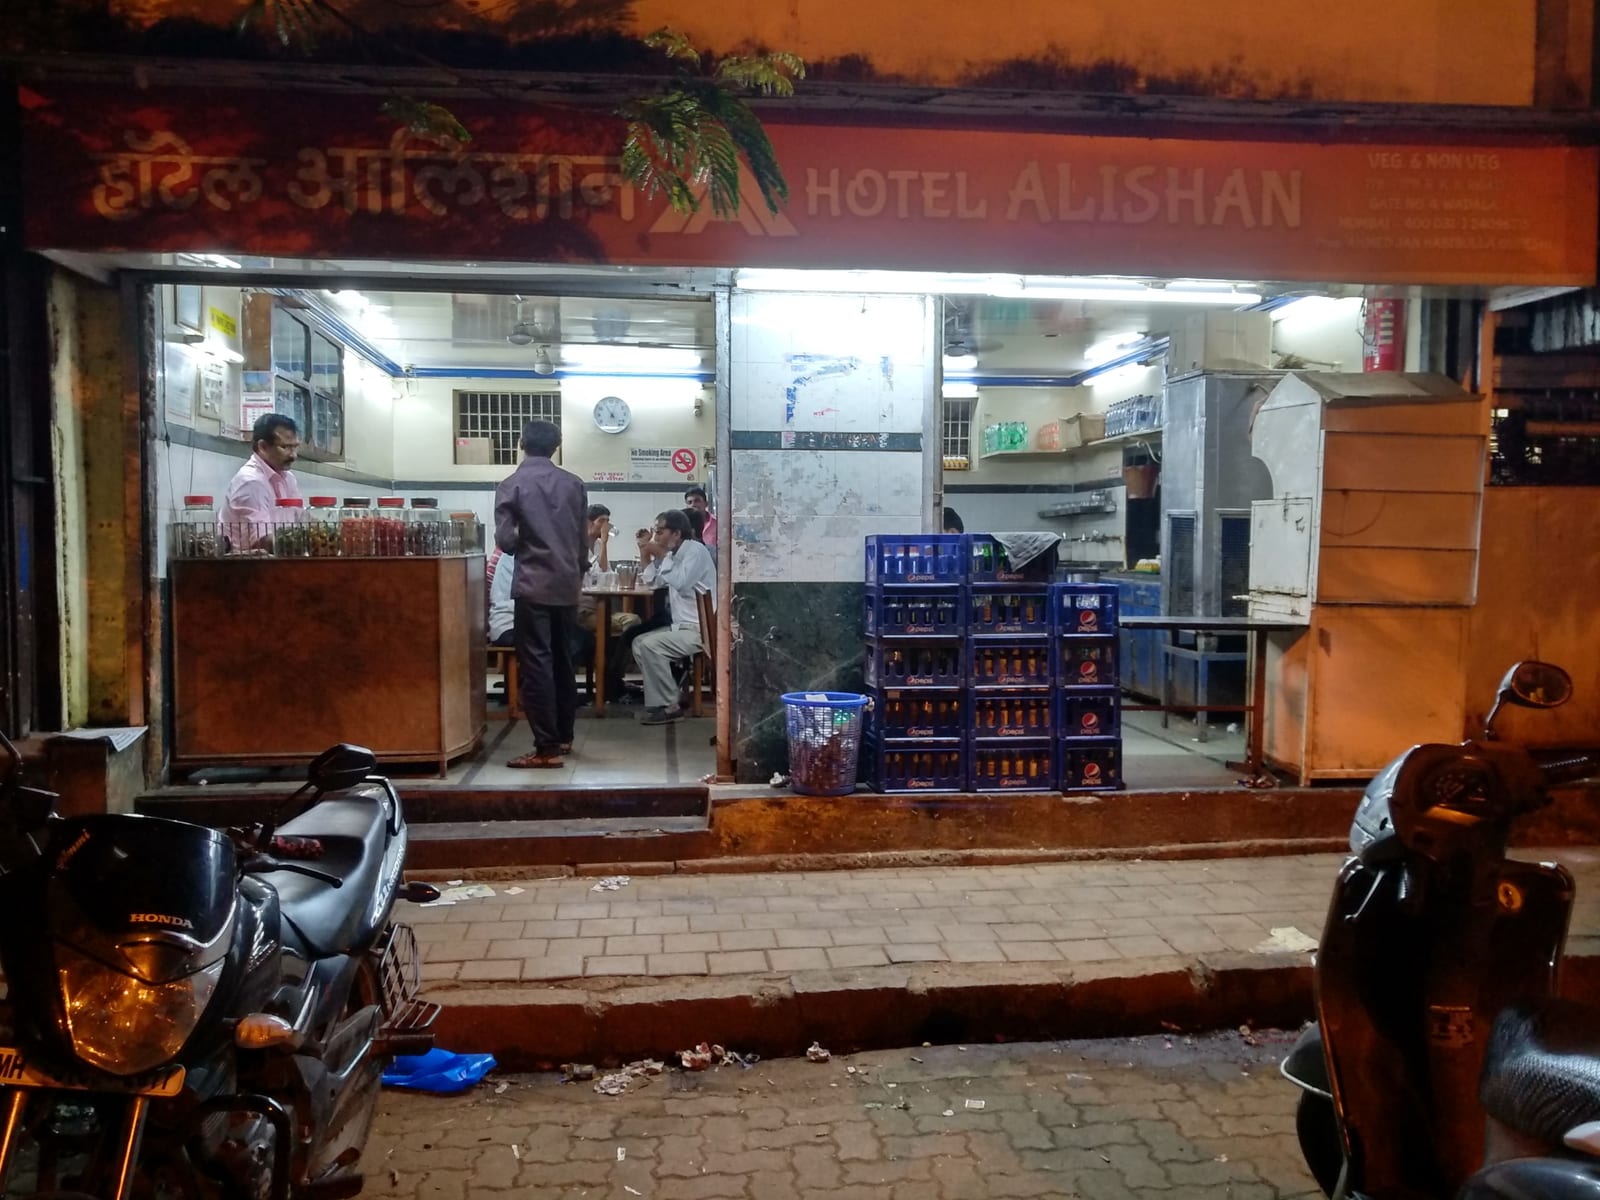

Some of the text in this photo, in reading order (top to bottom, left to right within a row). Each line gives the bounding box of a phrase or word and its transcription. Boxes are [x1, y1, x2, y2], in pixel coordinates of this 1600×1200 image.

[1426, 152, 1462, 169] NON
[1465, 153, 1500, 171] VEG
[805, 160, 1303, 228] HOTEL ALISHAN
[129, 913, 194, 929] HONDA
